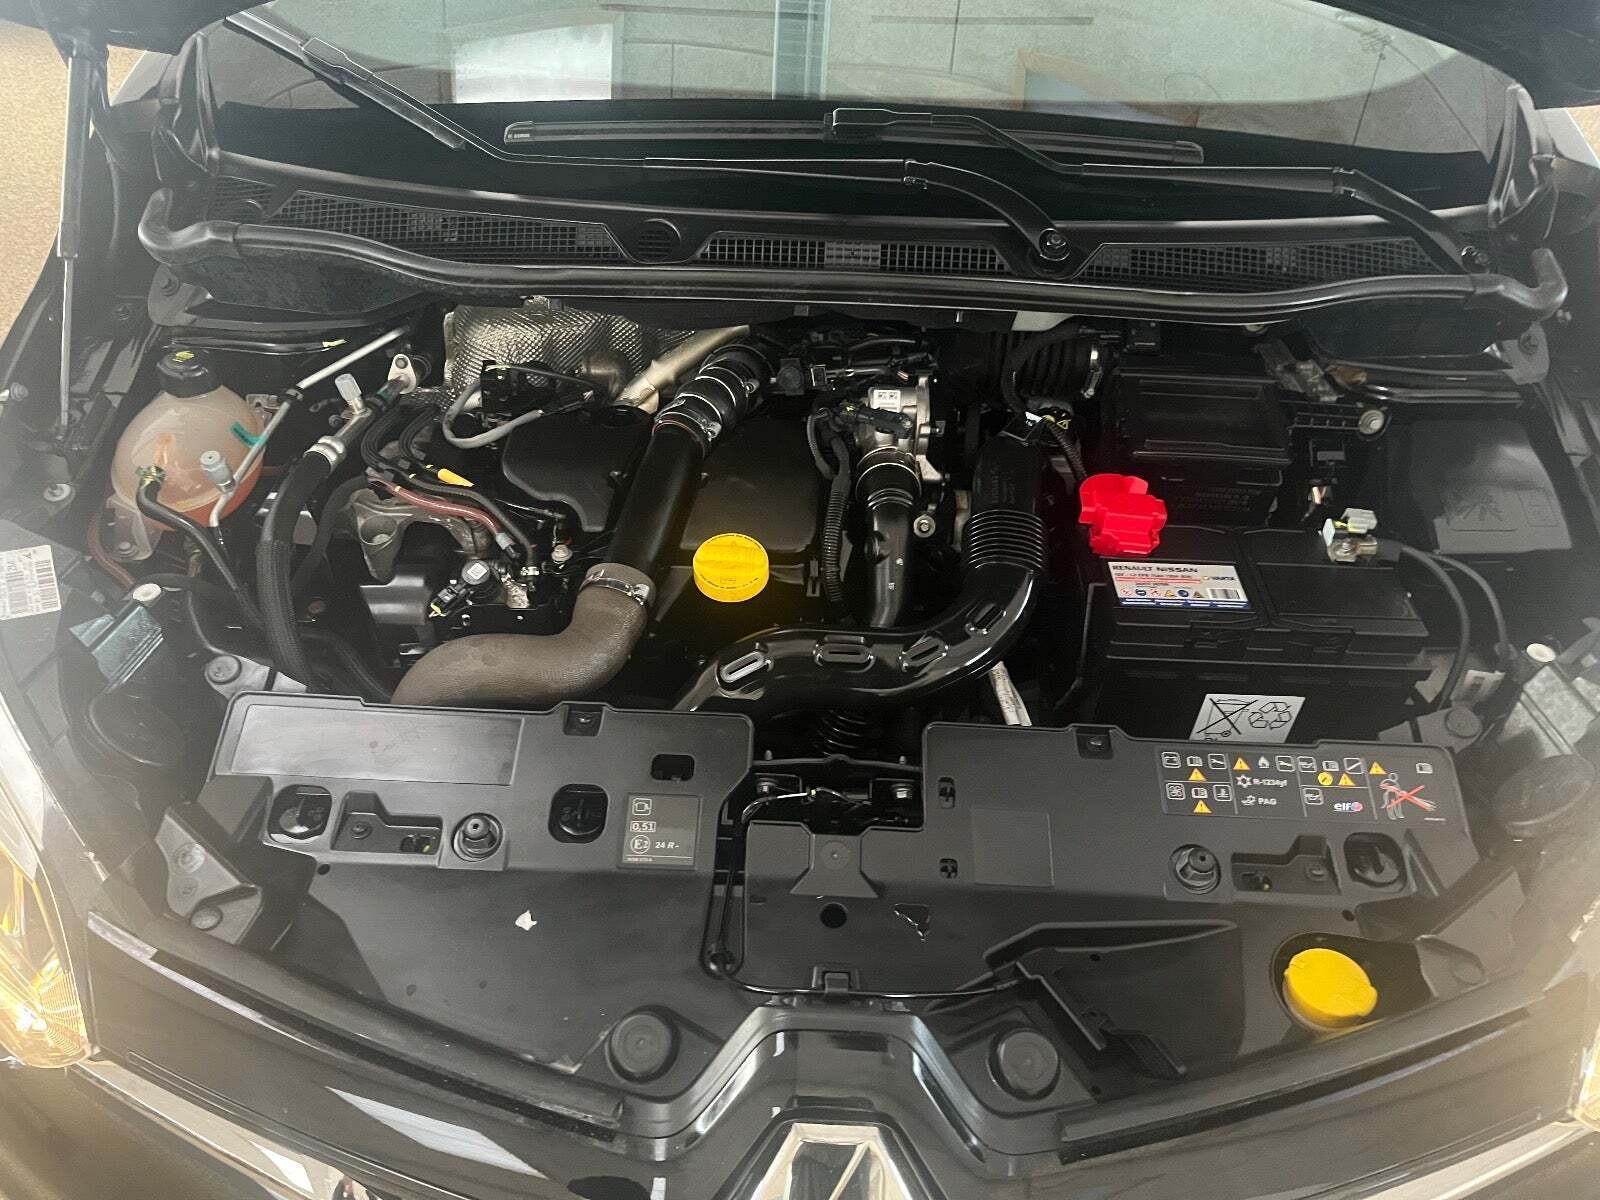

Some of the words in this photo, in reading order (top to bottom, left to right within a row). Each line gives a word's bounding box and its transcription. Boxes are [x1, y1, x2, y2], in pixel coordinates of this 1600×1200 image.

[1252, 778, 1288, 787] R-1234yf
[1257, 797, 1277, 805] PAG
[1333, 801, 1351, 811] elf
[655, 841, 666, 849] 24
